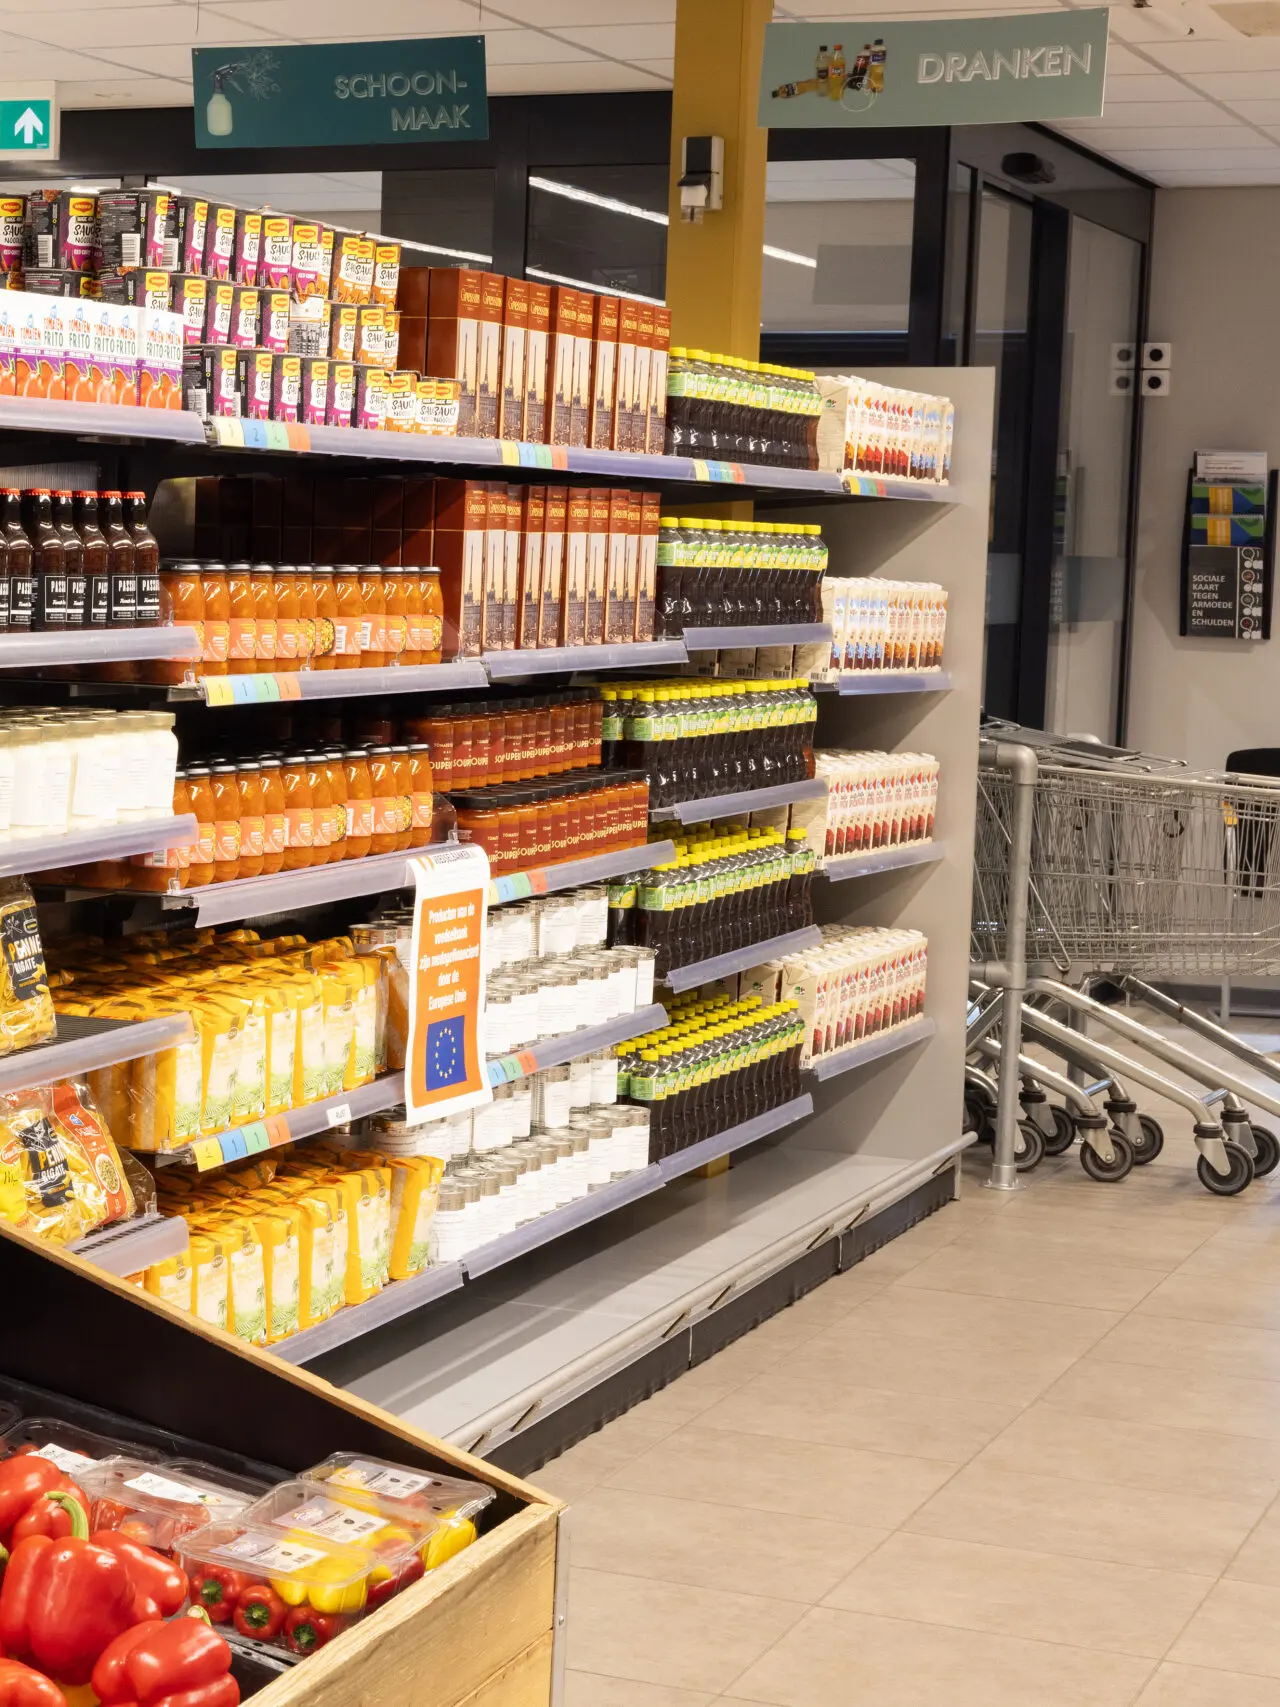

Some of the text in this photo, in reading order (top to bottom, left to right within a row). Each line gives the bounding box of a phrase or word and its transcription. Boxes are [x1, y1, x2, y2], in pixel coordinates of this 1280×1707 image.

[917, 43, 1092, 84] DRANKEN
[334, 69, 468, 99] SCHOON-
[391, 104, 471, 132] MAAK
[44, 331, 63, 347] FRITO
[69, 333, 90, 349] FRITO
[94, 337, 114, 353] FRITO
[1192, 592, 1218, 600] TEGEN
[1192, 618, 1234, 626] SCHULDEN
[429, 900, 475, 924] Producten van de
[434, 925, 468, 944] voedselbank
[9, 935, 42, 962] PENNE
[14, 956, 36, 974] RIGATE
[420, 955, 431, 972] zijn
[438, 969, 459, 987] door de
[428, 988, 466, 1011] Europese Unie
